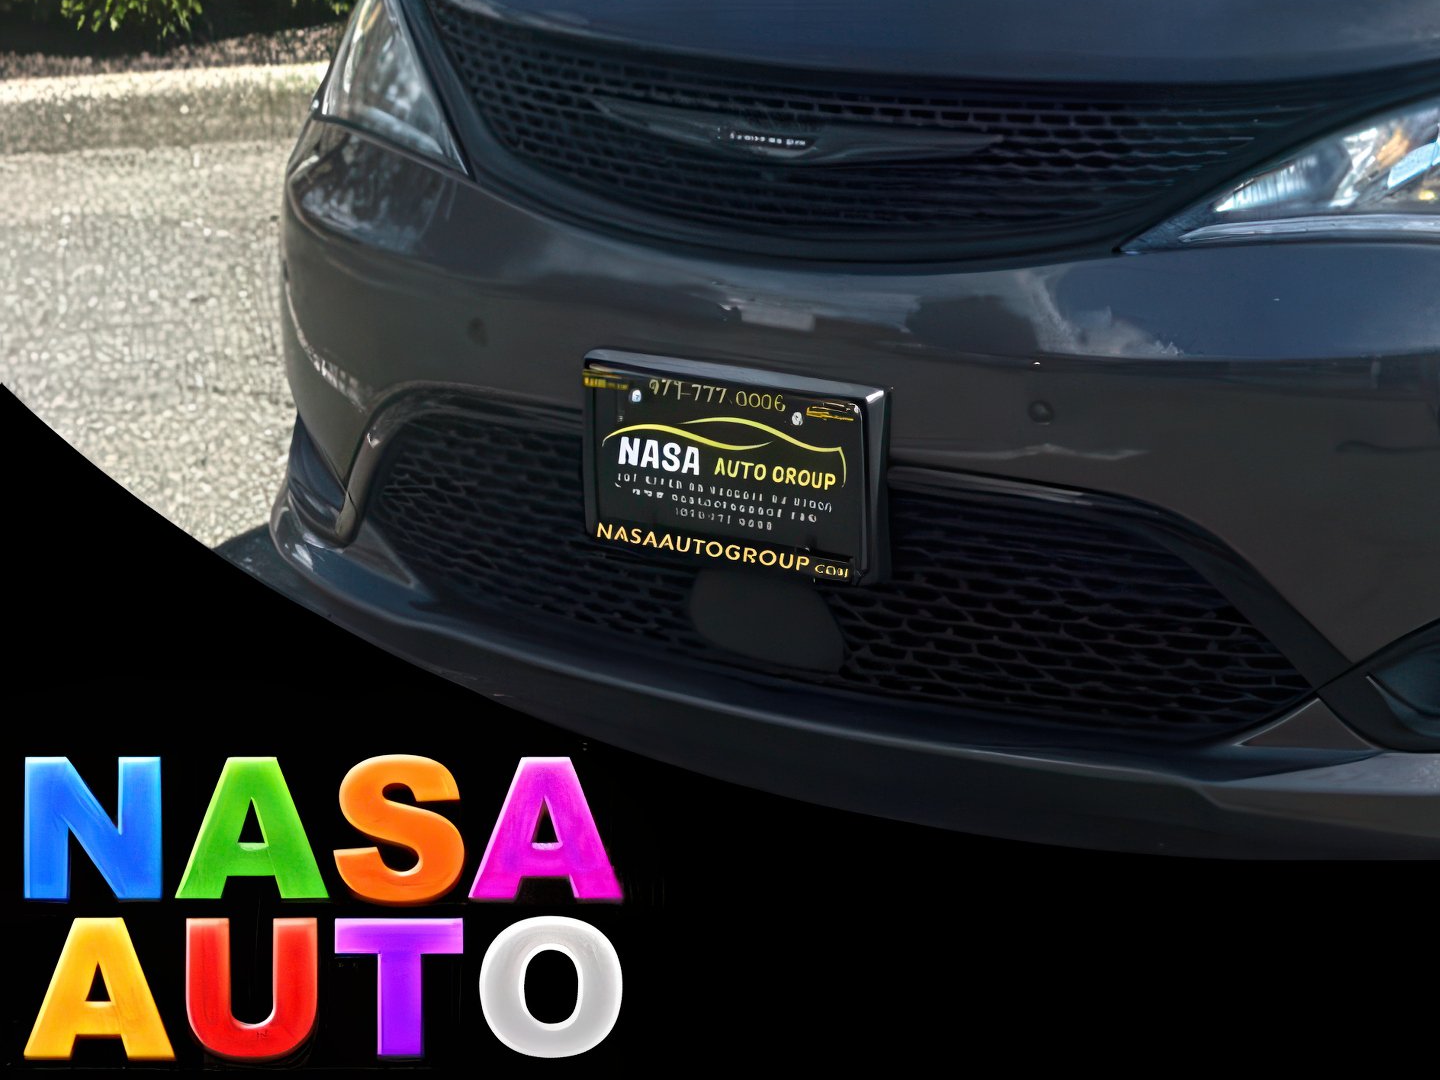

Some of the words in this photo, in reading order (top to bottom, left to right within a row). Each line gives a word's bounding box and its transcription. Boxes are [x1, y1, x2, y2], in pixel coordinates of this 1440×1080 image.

[618, 436, 700, 476] NASA
[714, 457, 767, 481] AUTO
[596, 522, 810, 571] NASAAUTOGROUP
